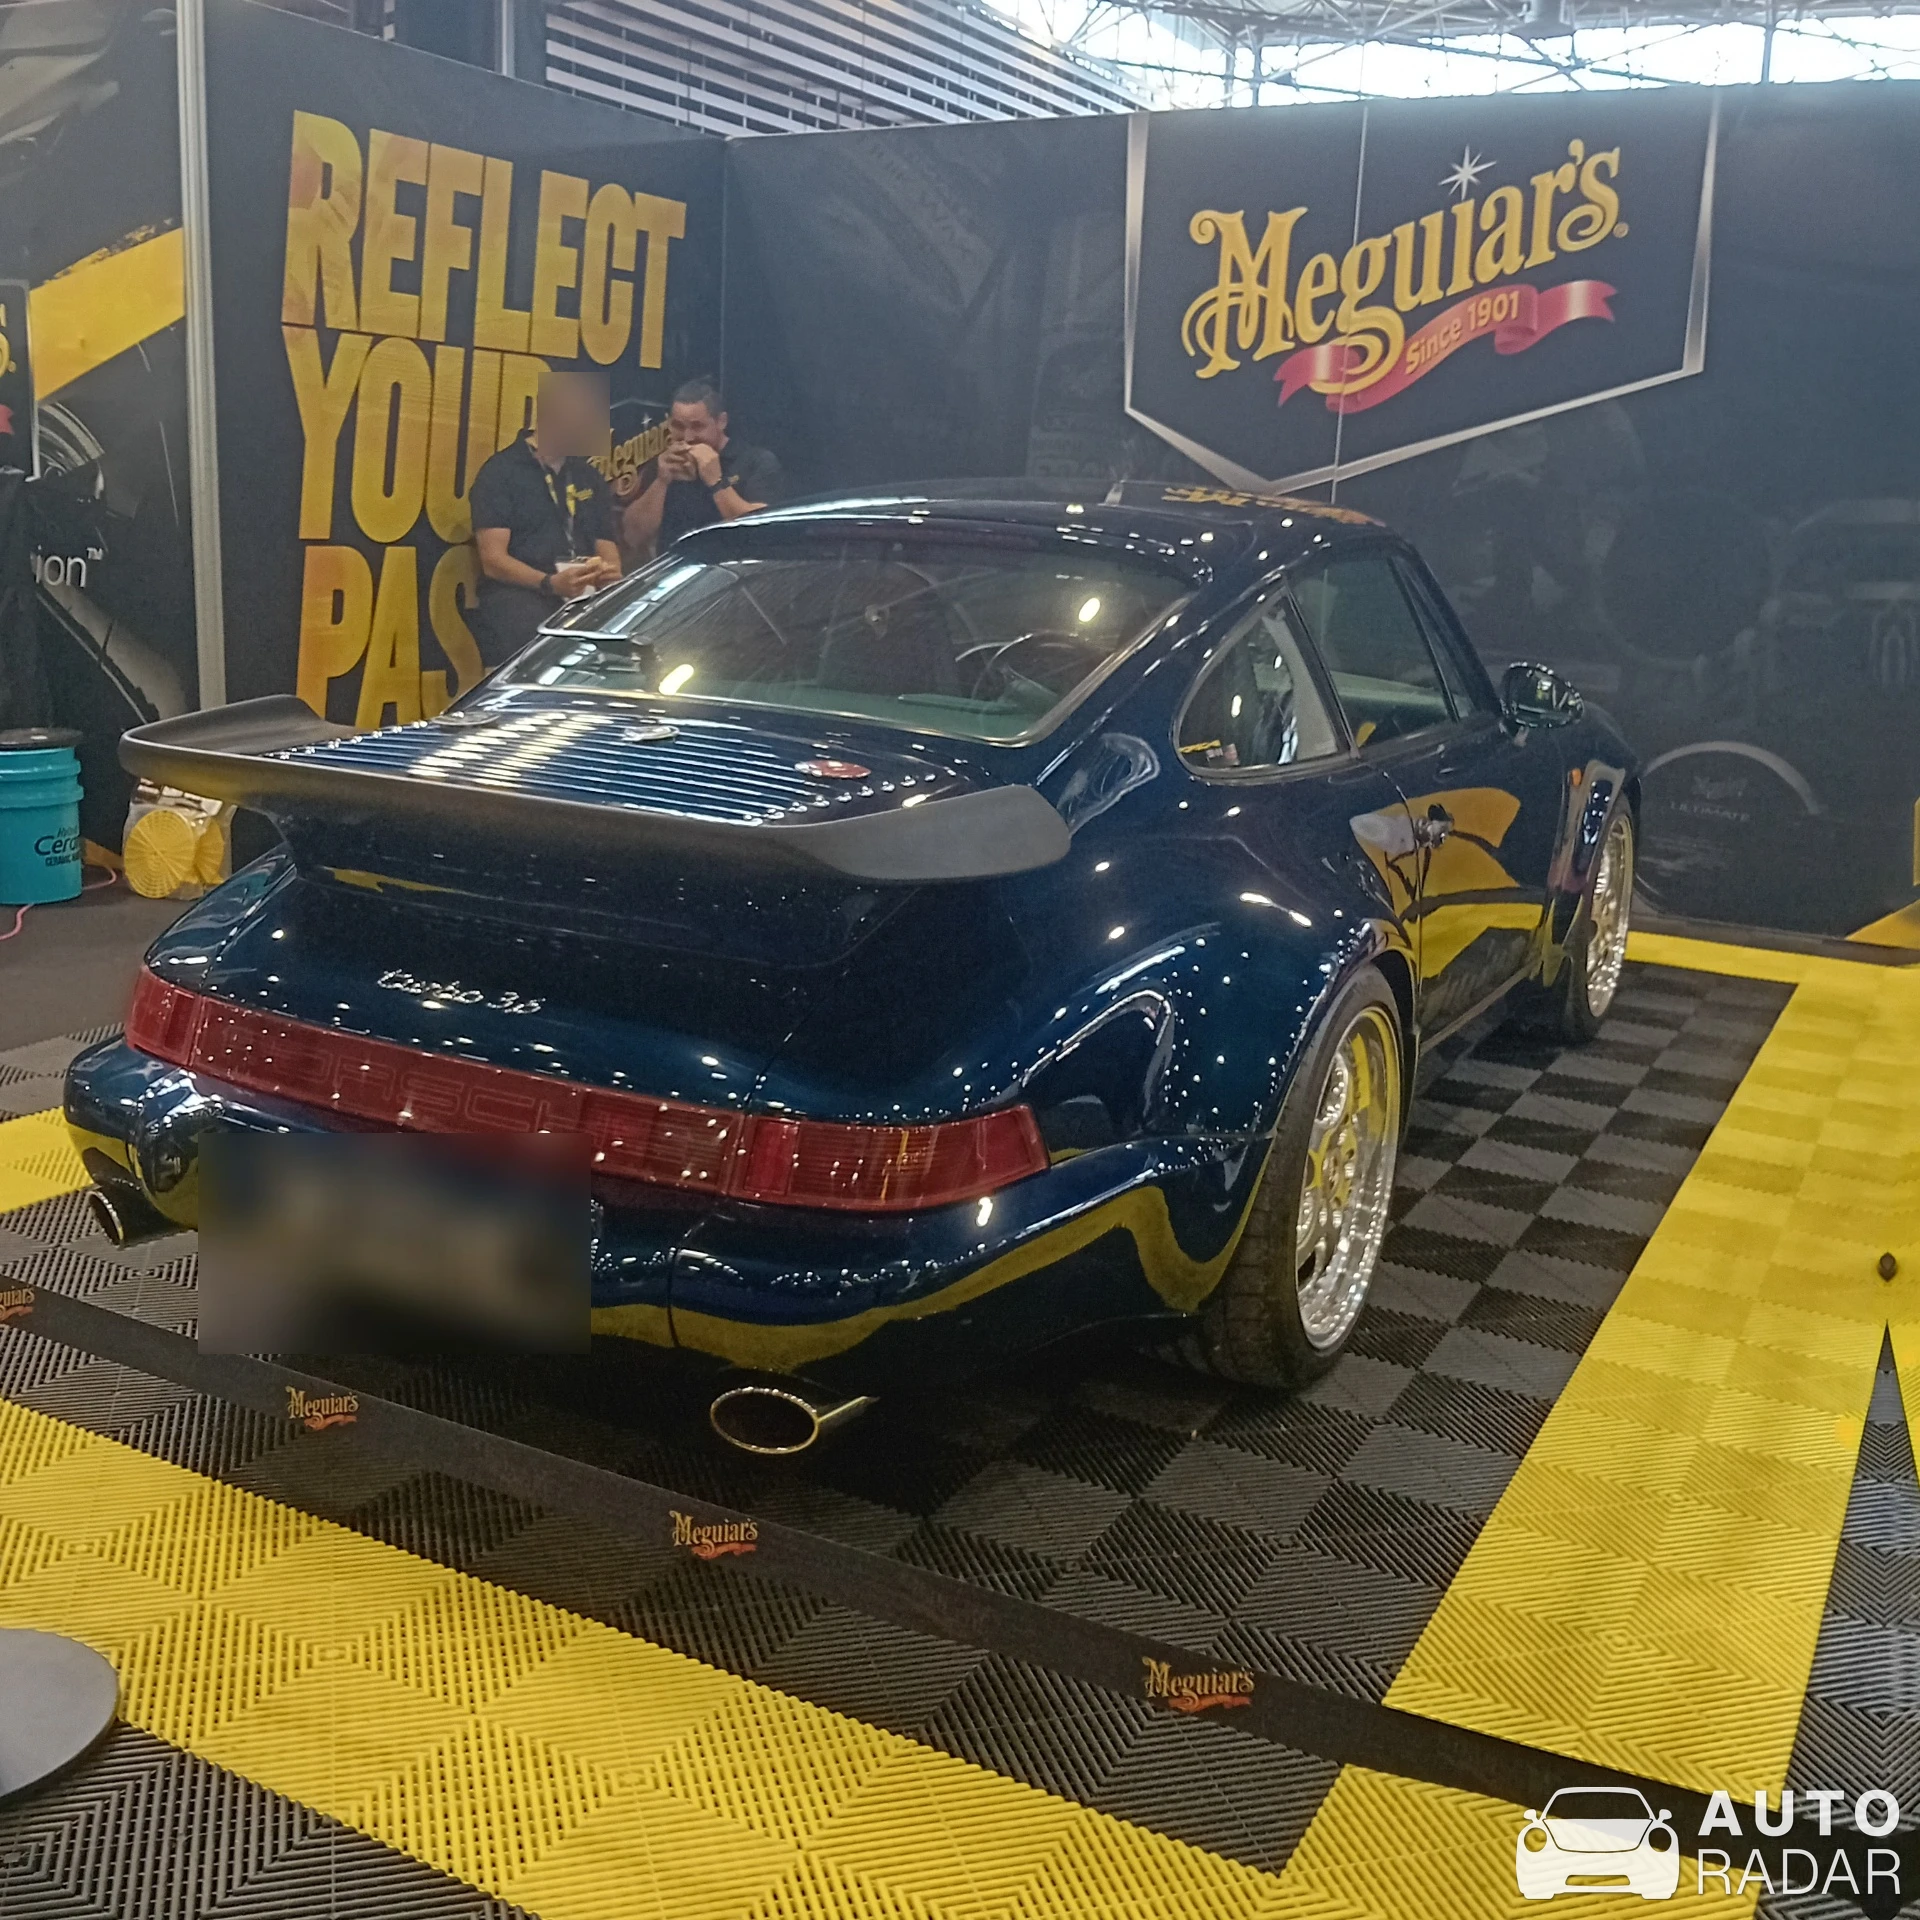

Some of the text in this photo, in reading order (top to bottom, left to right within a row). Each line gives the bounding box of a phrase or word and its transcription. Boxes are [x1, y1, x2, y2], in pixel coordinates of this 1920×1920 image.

[281, 110, 688, 370] REFLECT
[1181, 138, 1622, 396] Meguiar's
[1404, 290, 1521, 376] Since 1901
[296, 545, 496, 730] PAS
[284, 1385, 359, 1430] Meguiar's
[668, 1510, 759, 1557] Meguiar's
[1142, 1656, 1255, 1712] Meguiar's
